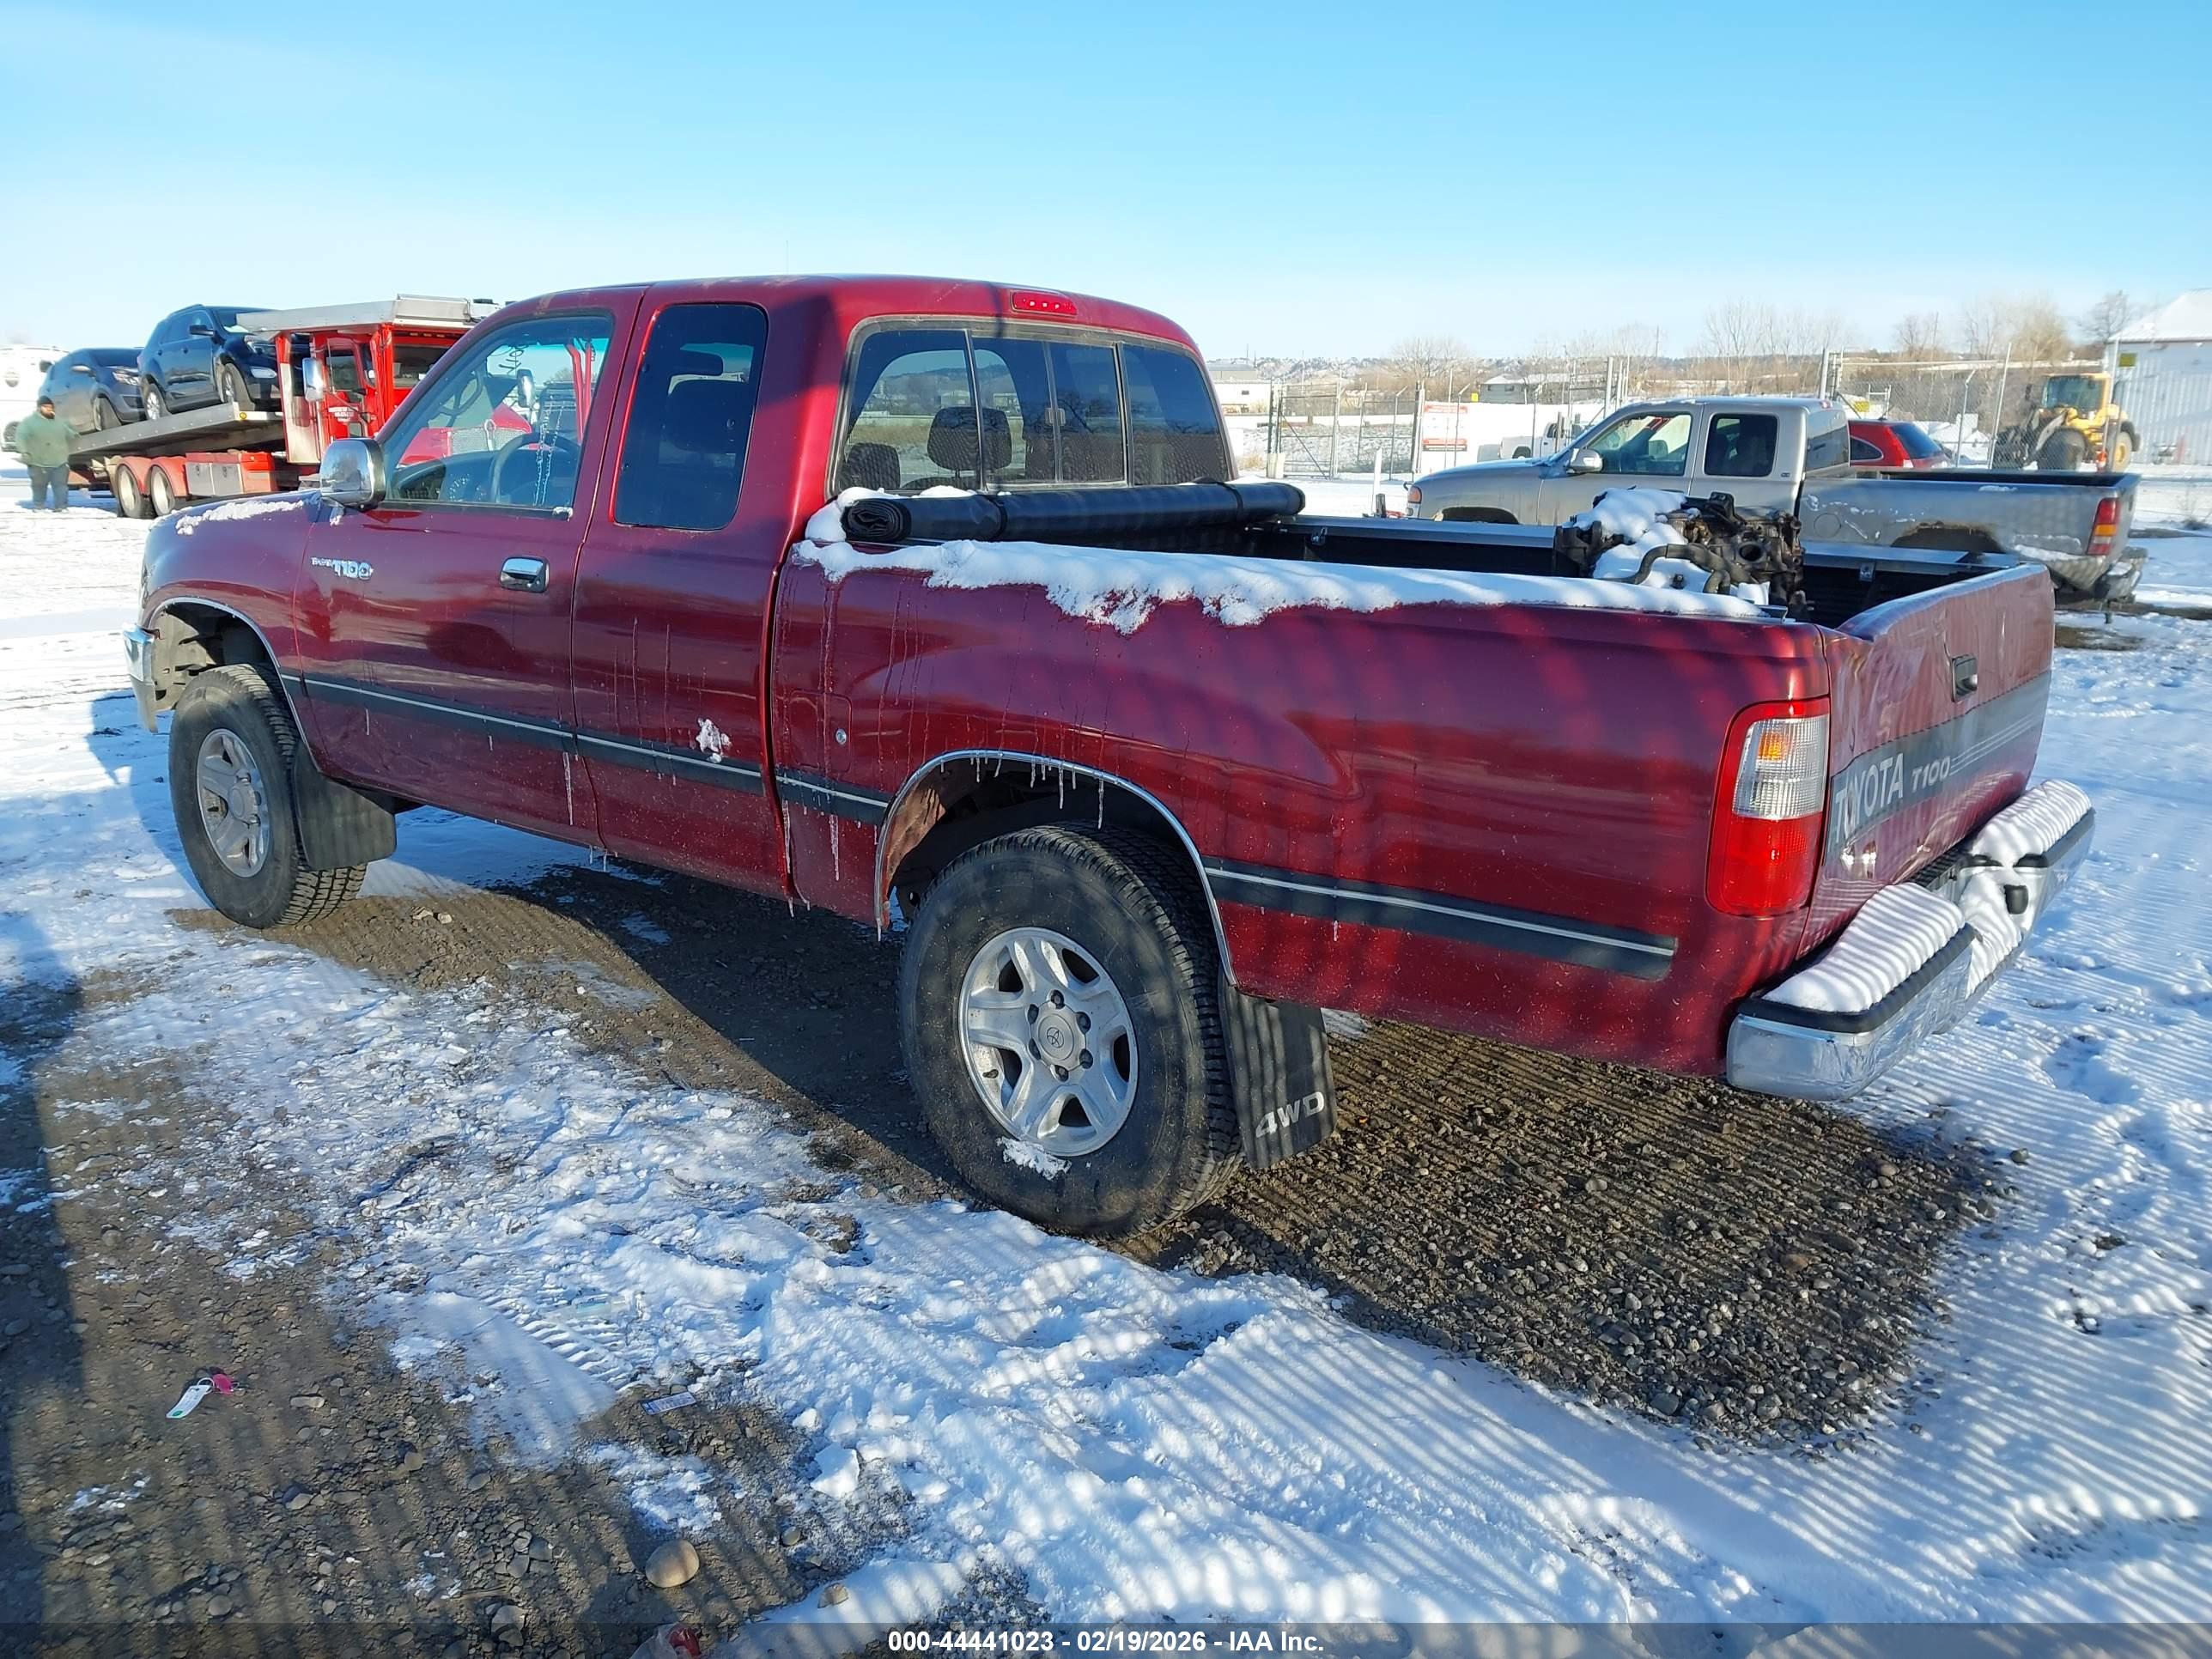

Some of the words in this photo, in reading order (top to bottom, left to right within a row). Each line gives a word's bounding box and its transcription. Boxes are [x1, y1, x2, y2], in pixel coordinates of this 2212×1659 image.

[1836, 753, 1904, 843] TOYOTA
[1911, 756, 1950, 793] T100
[1255, 1091, 1325, 1138] 4WD
